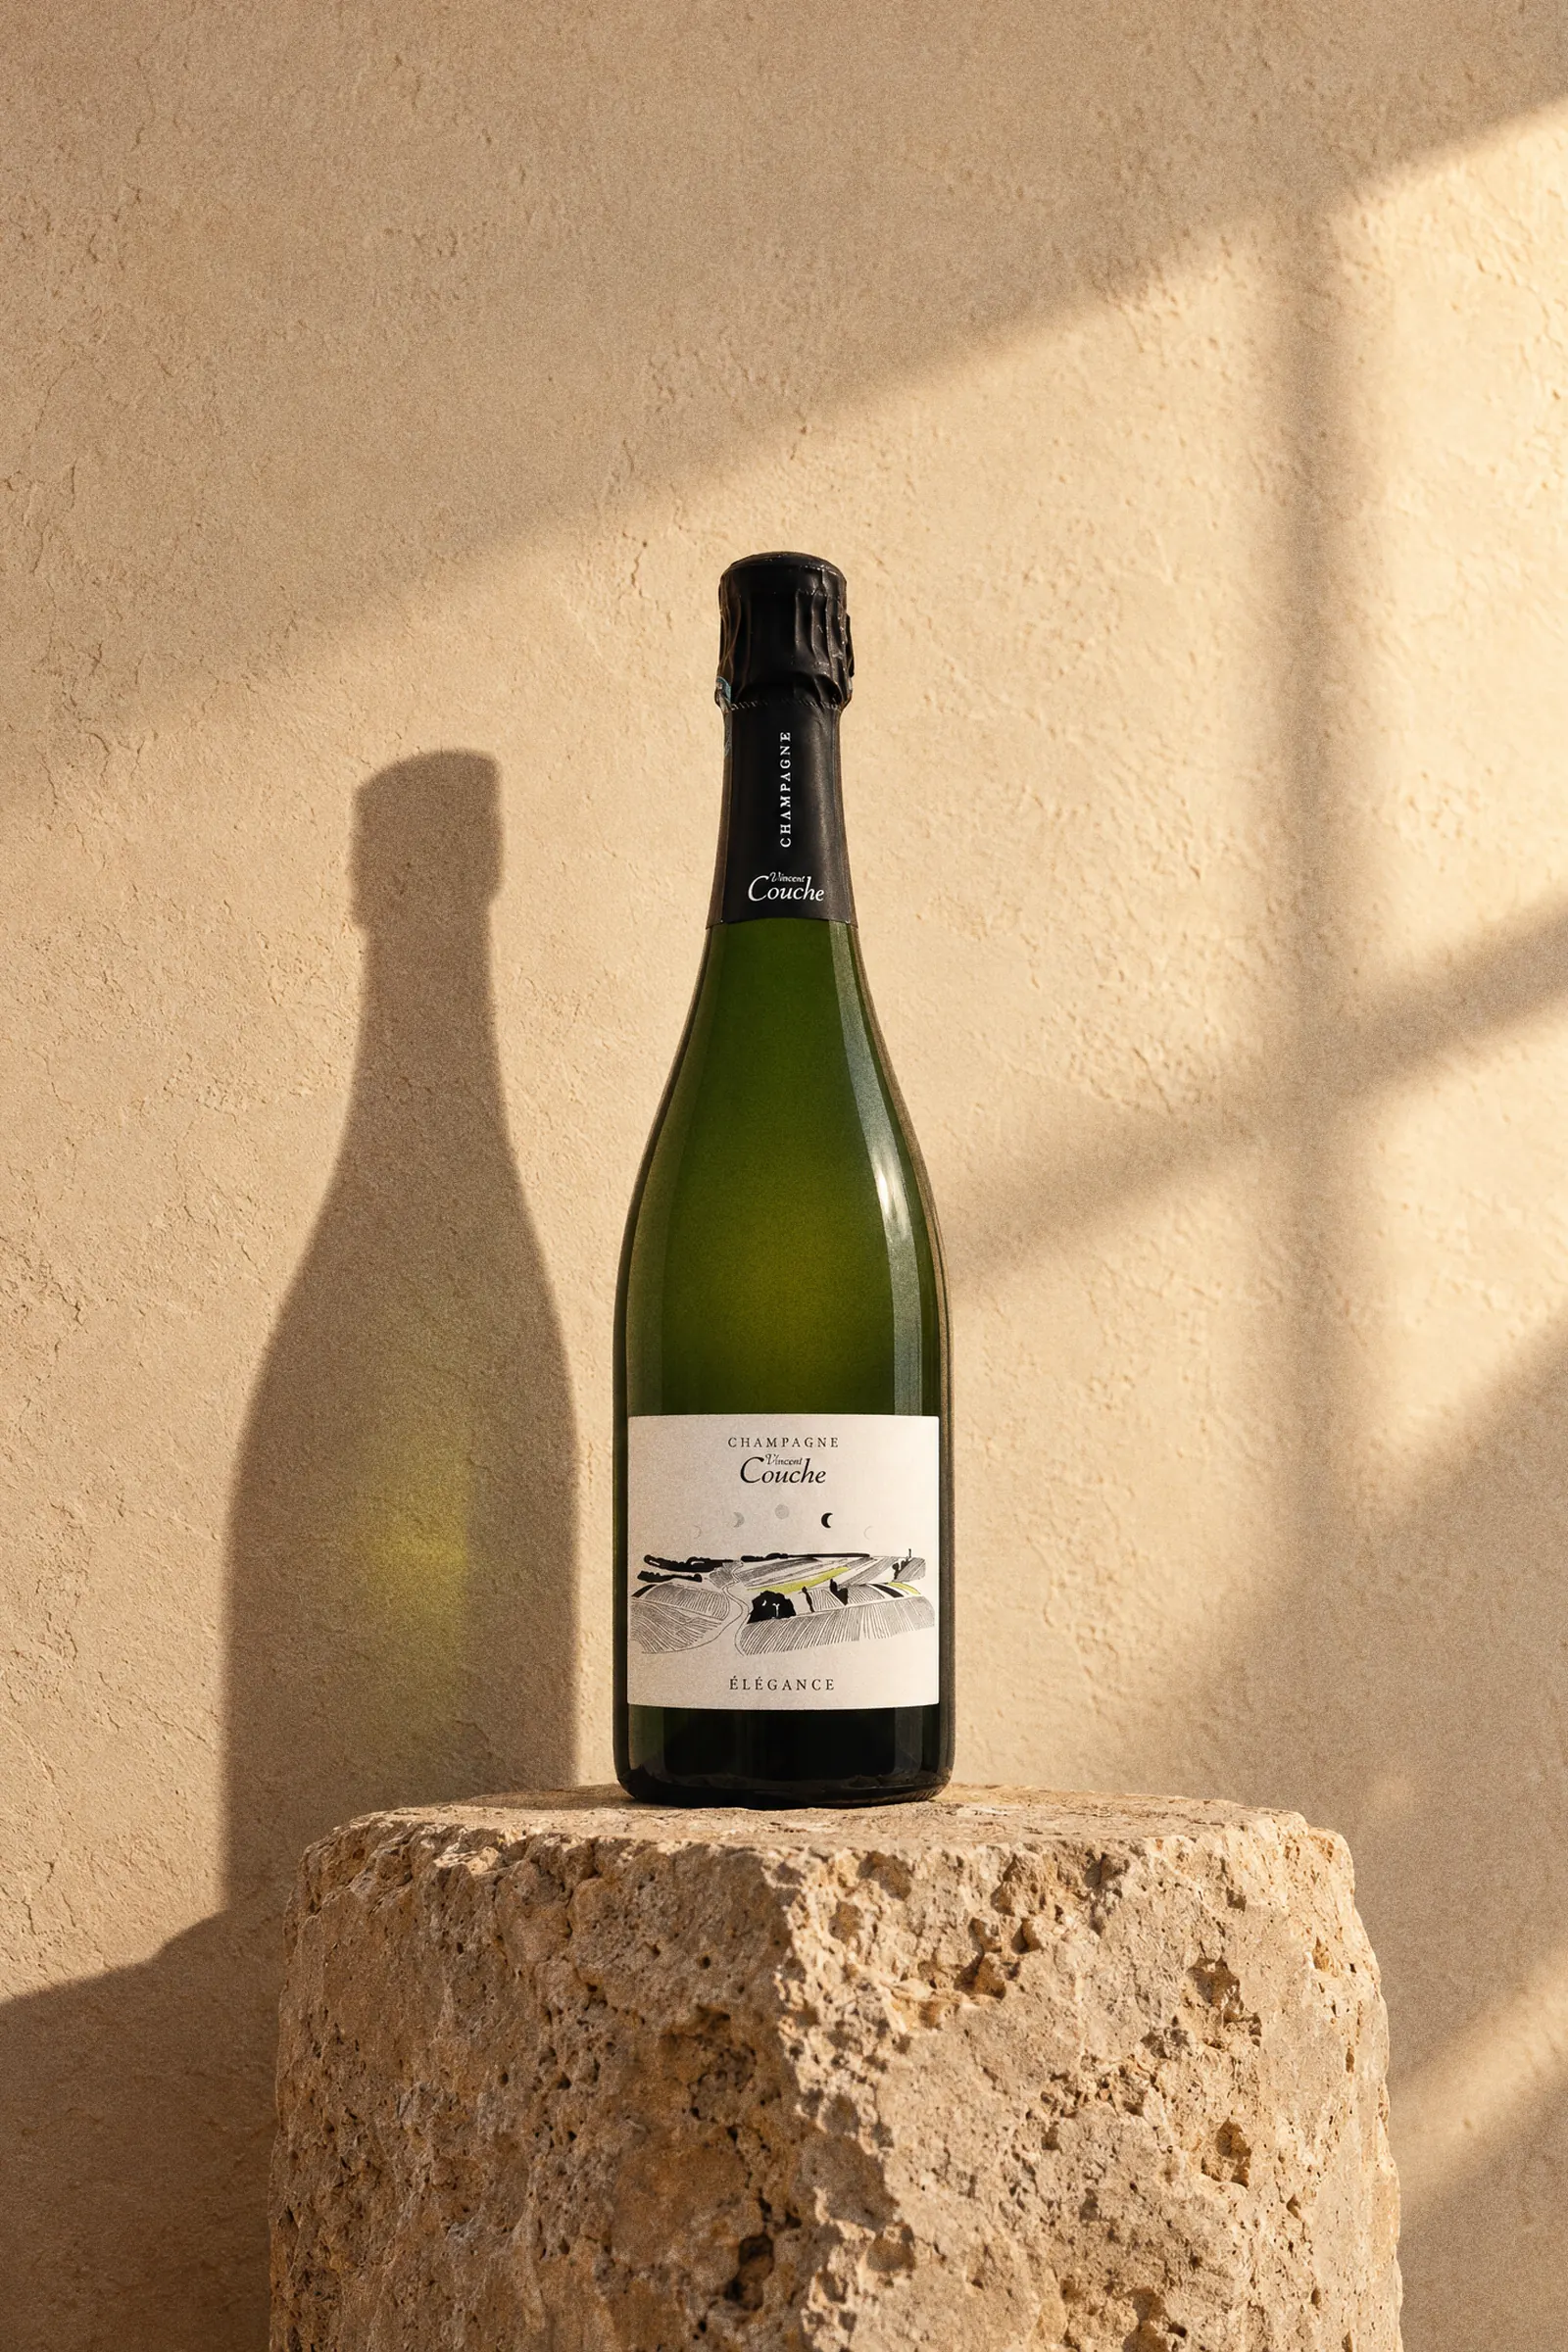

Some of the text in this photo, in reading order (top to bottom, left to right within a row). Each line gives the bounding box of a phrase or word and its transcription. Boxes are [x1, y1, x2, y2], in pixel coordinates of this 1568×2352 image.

[780, 731, 792, 848] CHAMPAGNE
[769, 871, 805, 883] Vincent
[748, 875, 825, 902] Couche
[728, 1437, 839, 1448] CHAMPAGNE
[764, 1453, 803, 1466] Vincent
[740, 1456, 826, 1484] Couche
[728, 1675, 835, 1691] ÉLÉGANCE
